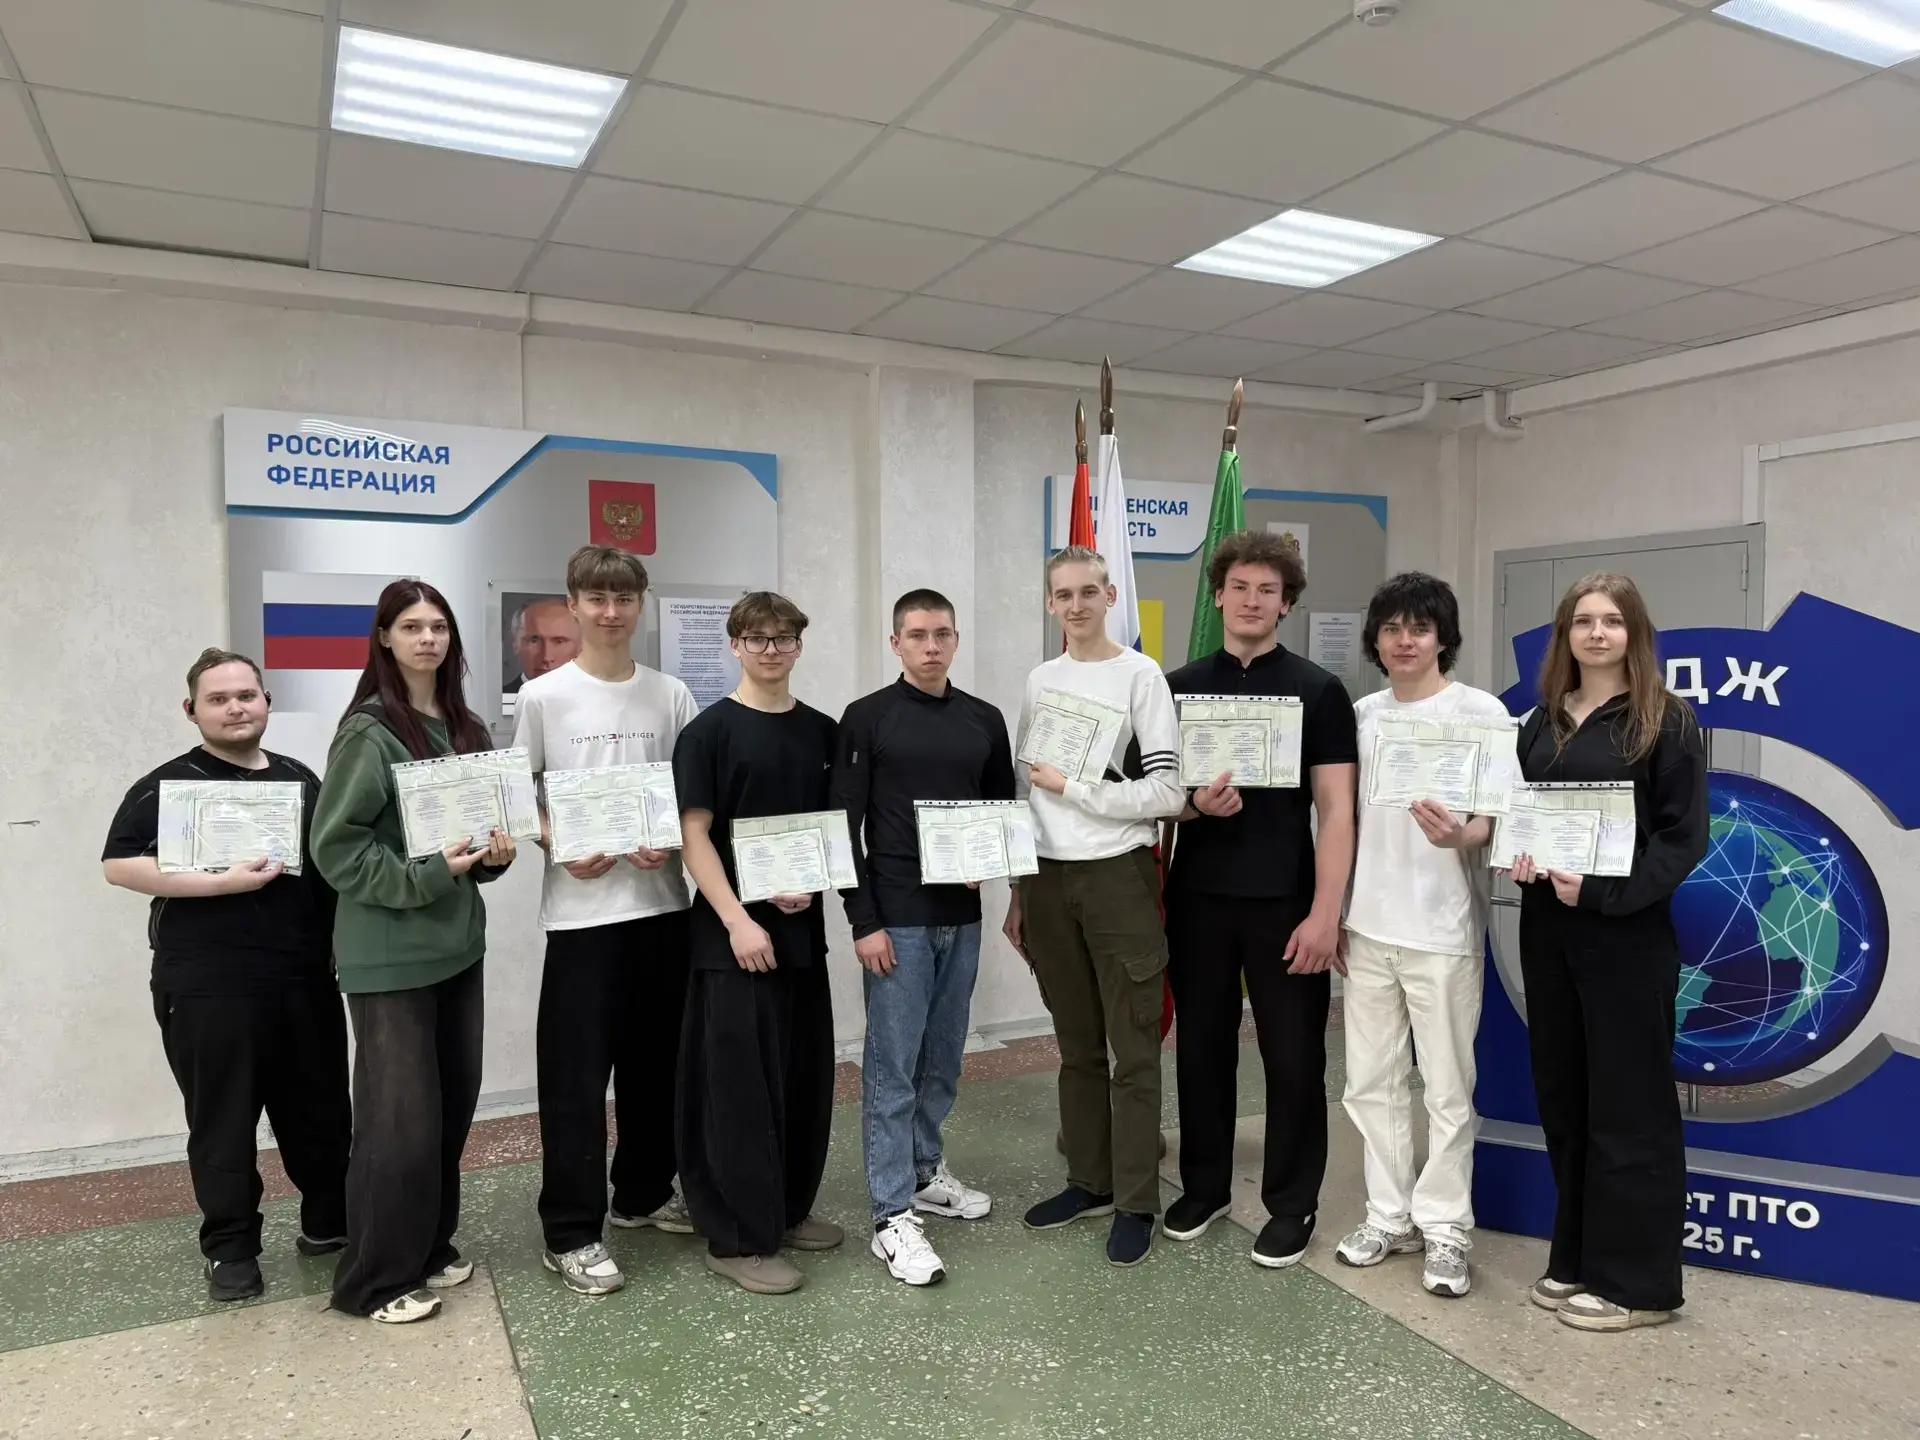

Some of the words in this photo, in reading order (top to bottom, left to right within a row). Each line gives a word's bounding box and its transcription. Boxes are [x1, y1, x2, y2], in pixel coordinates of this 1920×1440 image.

[267, 433, 450, 465] РОССИЙСКАЯ
[267, 465, 435, 495] ФЕДЕРАЦИЯ
[1089, 496, 1188, 515] ЕНСКАЯ
[570, 735, 606, 745] TOMMY
[1728, 1191, 1820, 1229] ПТО
[1682, 1221, 1724, 1254] 25
[1733, 1235, 1761, 1259] г.
